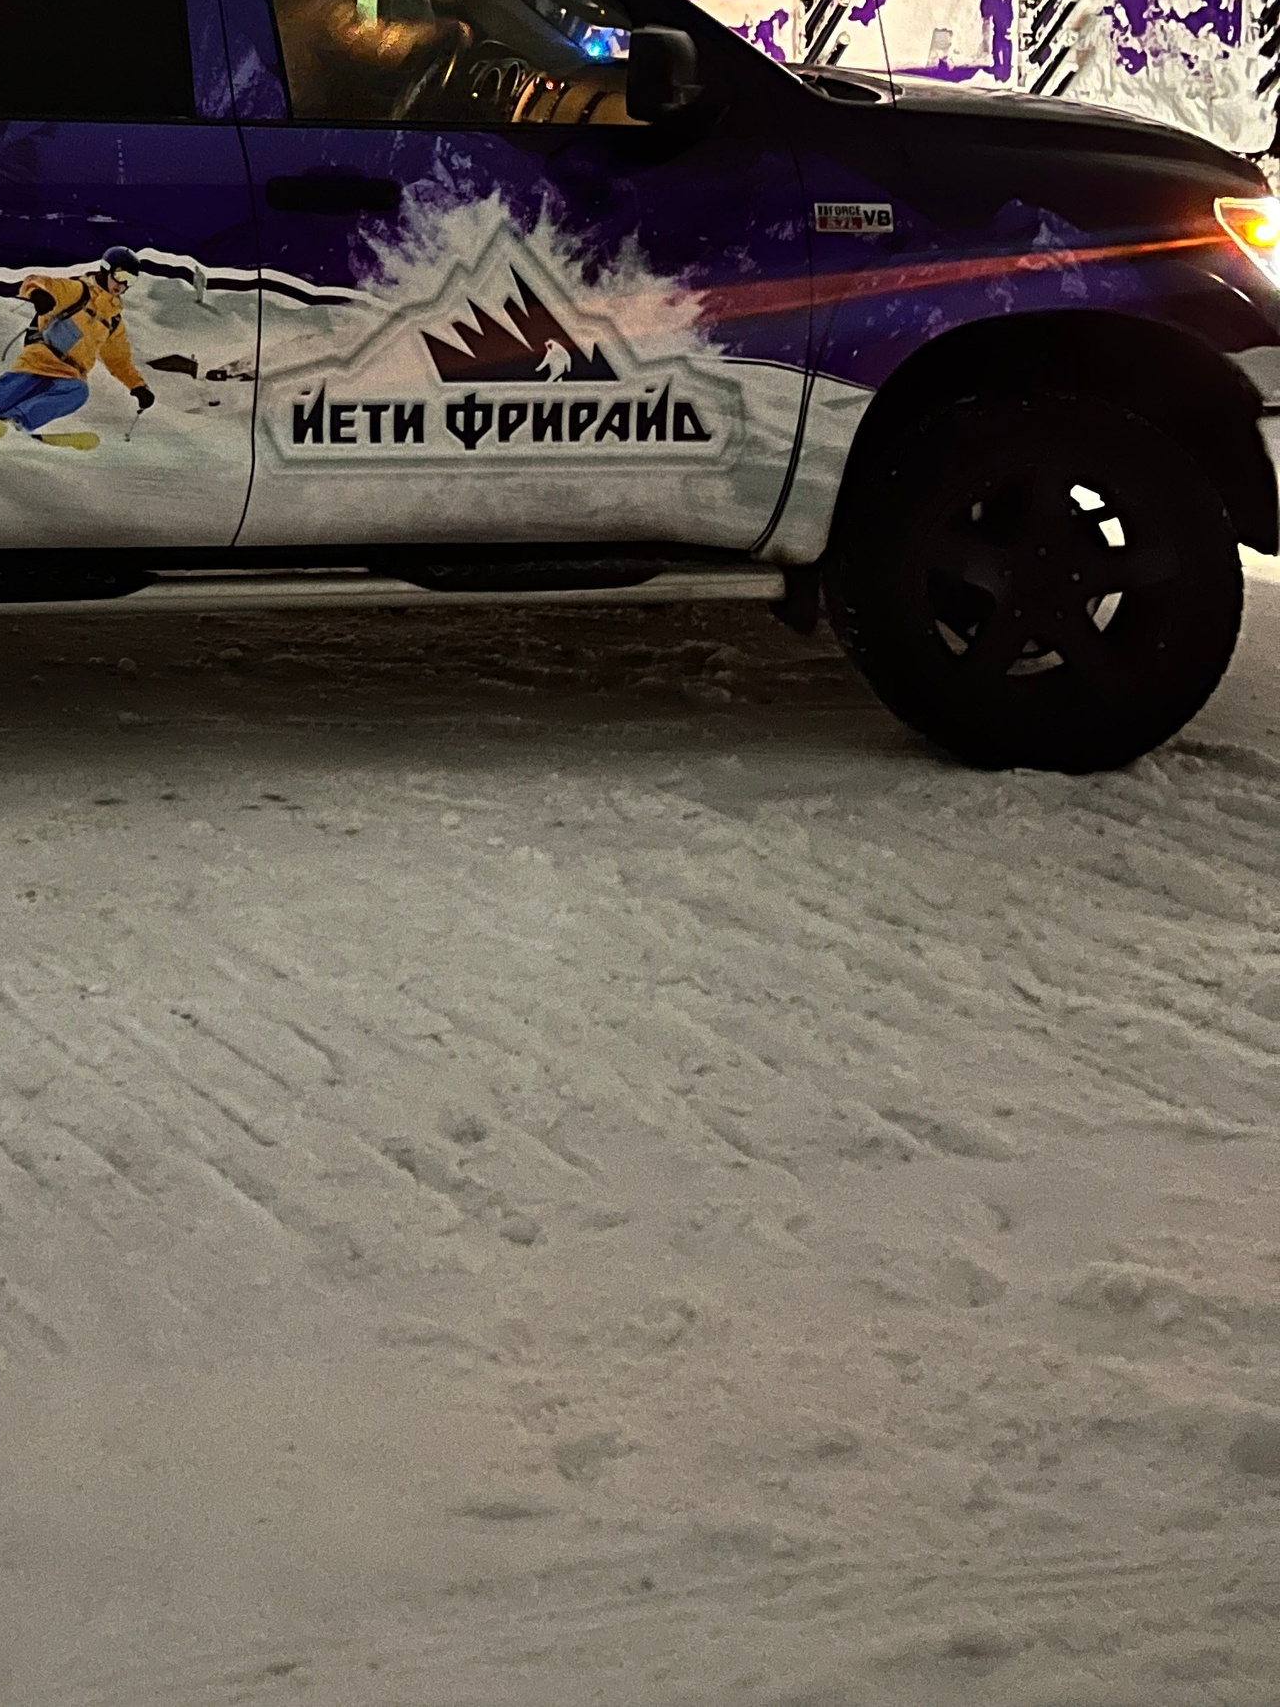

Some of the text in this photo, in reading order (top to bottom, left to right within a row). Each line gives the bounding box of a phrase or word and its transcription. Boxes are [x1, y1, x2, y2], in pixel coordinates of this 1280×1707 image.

[863, 209, 891, 226] V8
[292, 375, 713, 451] ЙЕТИ ФРИРАЙД
